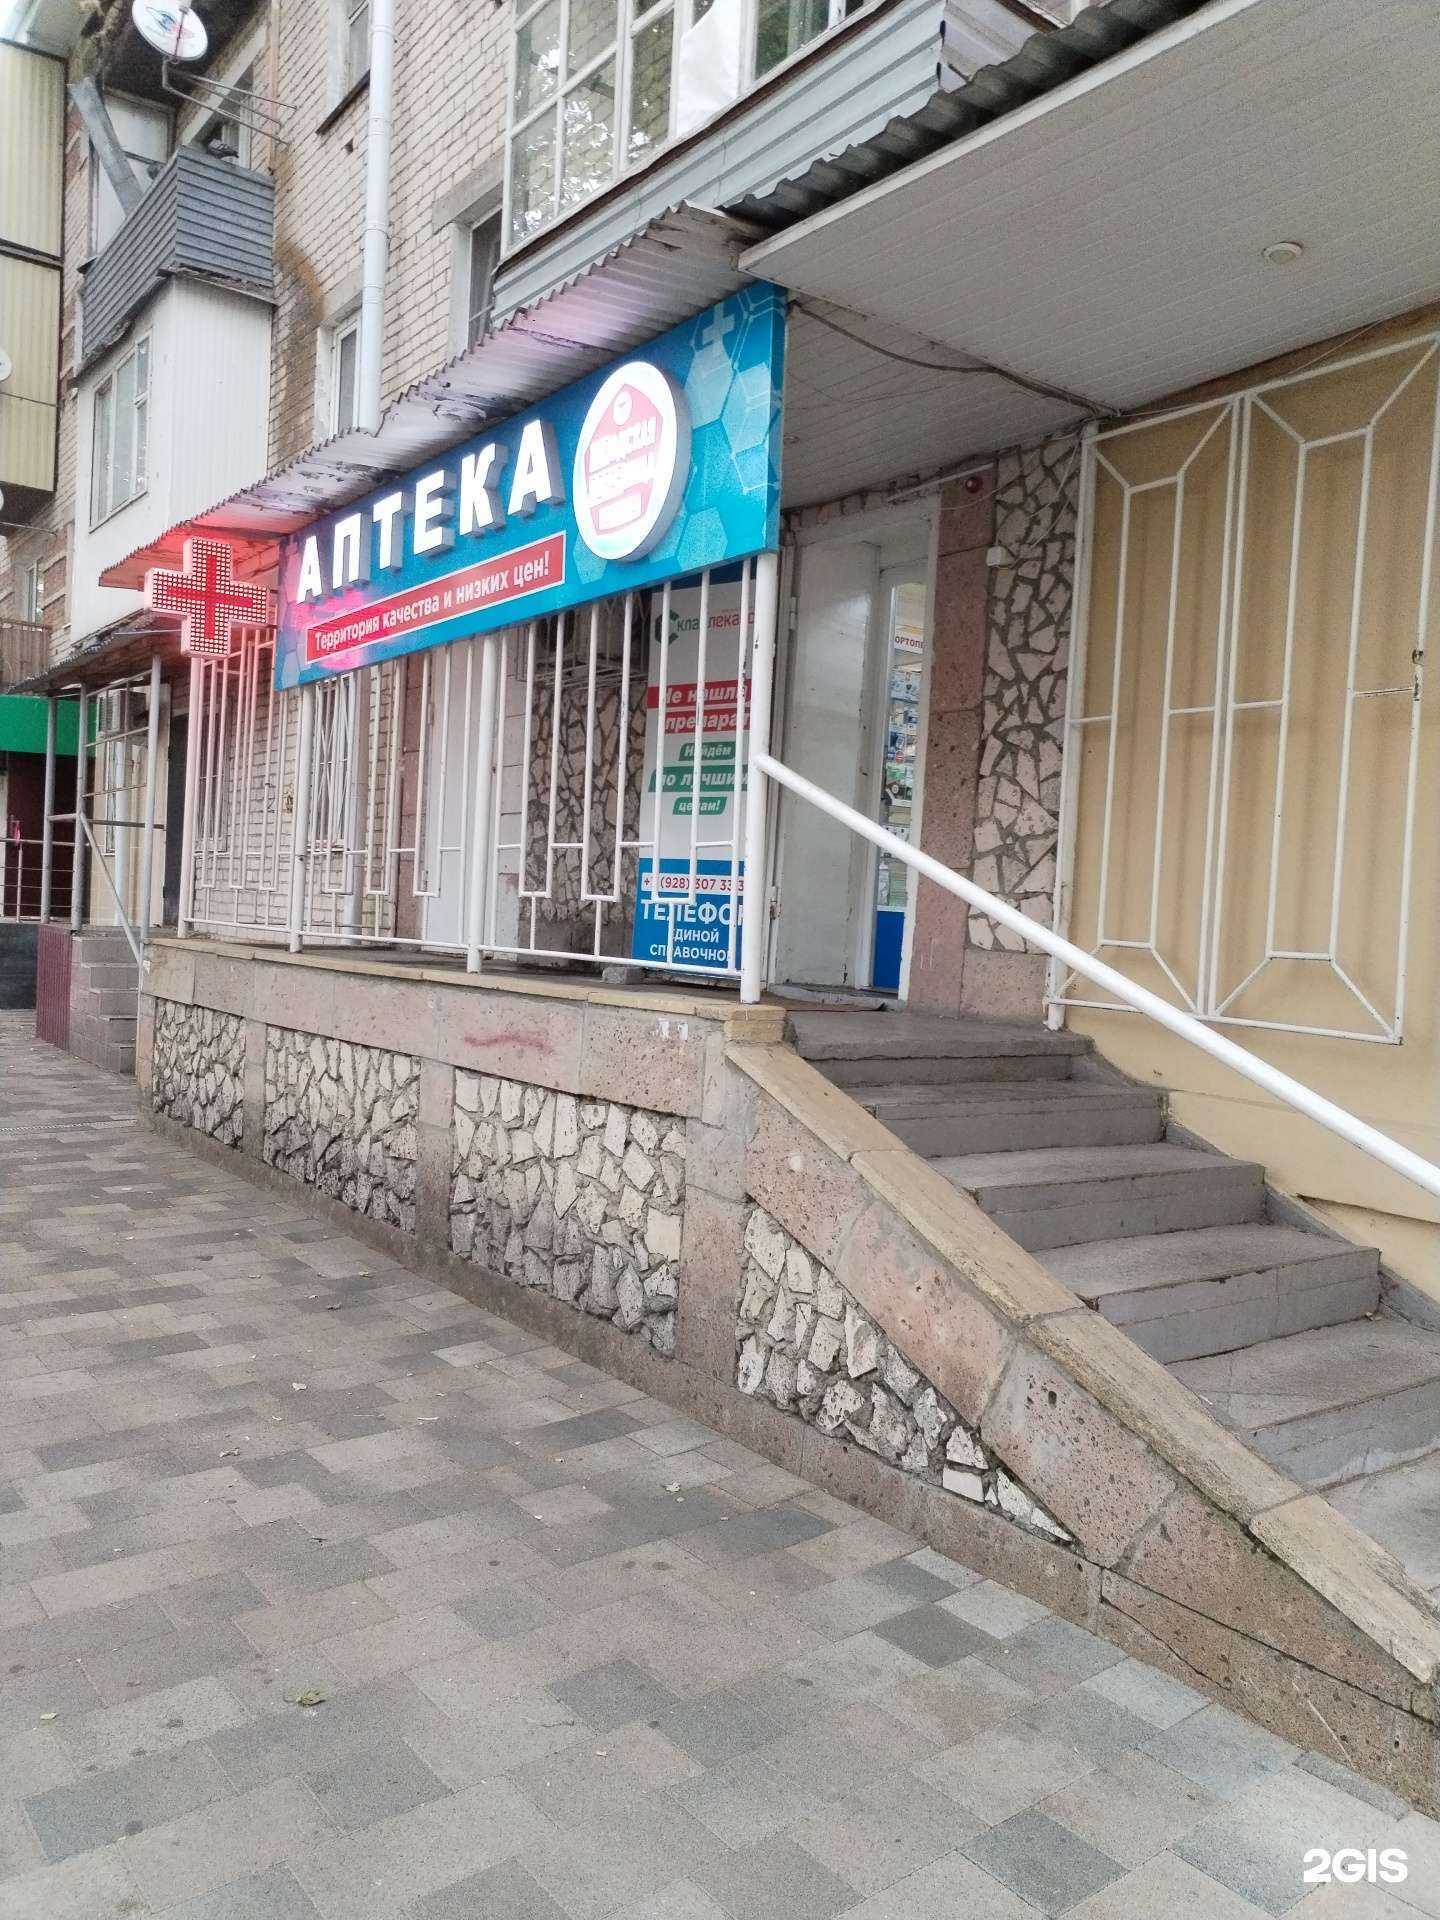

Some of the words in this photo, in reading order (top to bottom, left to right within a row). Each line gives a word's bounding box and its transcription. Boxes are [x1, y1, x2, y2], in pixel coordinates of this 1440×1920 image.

[296, 419, 555, 604] АПТЕКА
[315, 615, 380, 651] Территория
[383, 595, 440, 628] качества
[443, 590, 453, 609] и
[456, 570, 509, 605] низких
[513, 550, 550, 588] цен!
[665, 713, 750, 732] преарат
[684, 744, 731, 758] Нйдём
[679, 800, 720, 812] цеам!
[661, 876, 690, 889] (928)
[672, 928, 719, 943] ДИНОЙ
[650, 944, 731, 962] СПАВОЧНО
